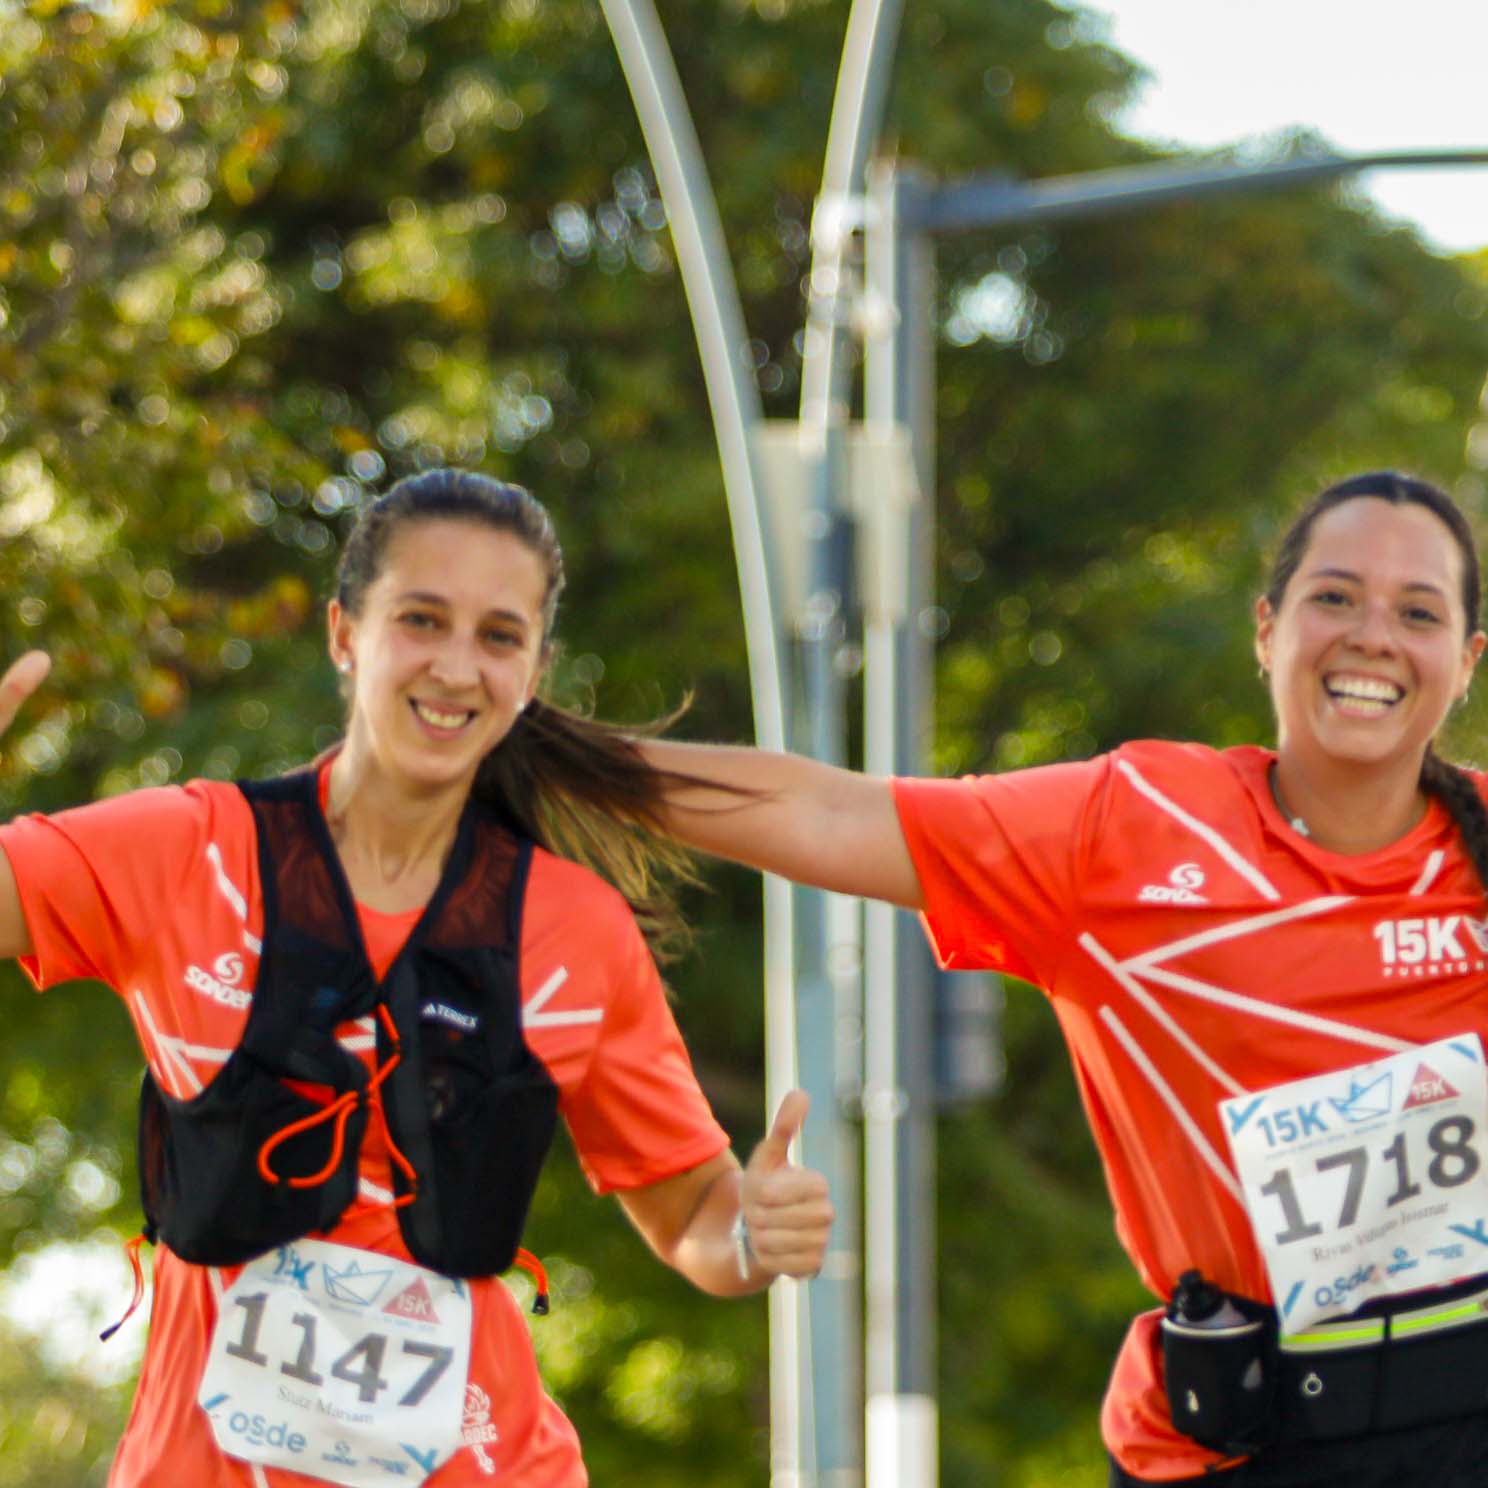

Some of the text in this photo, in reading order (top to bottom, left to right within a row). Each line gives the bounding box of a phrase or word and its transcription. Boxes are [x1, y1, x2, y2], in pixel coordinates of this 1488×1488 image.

[1373, 914, 1466, 963] 15K
[438, 1003, 478, 1028] TERREX
[1256, 1102, 1329, 1147] 15K
[1260, 1115, 1481, 1246] 1718
[225, 1292, 455, 1407] 1147
[229, 1411, 307, 1453] osde
